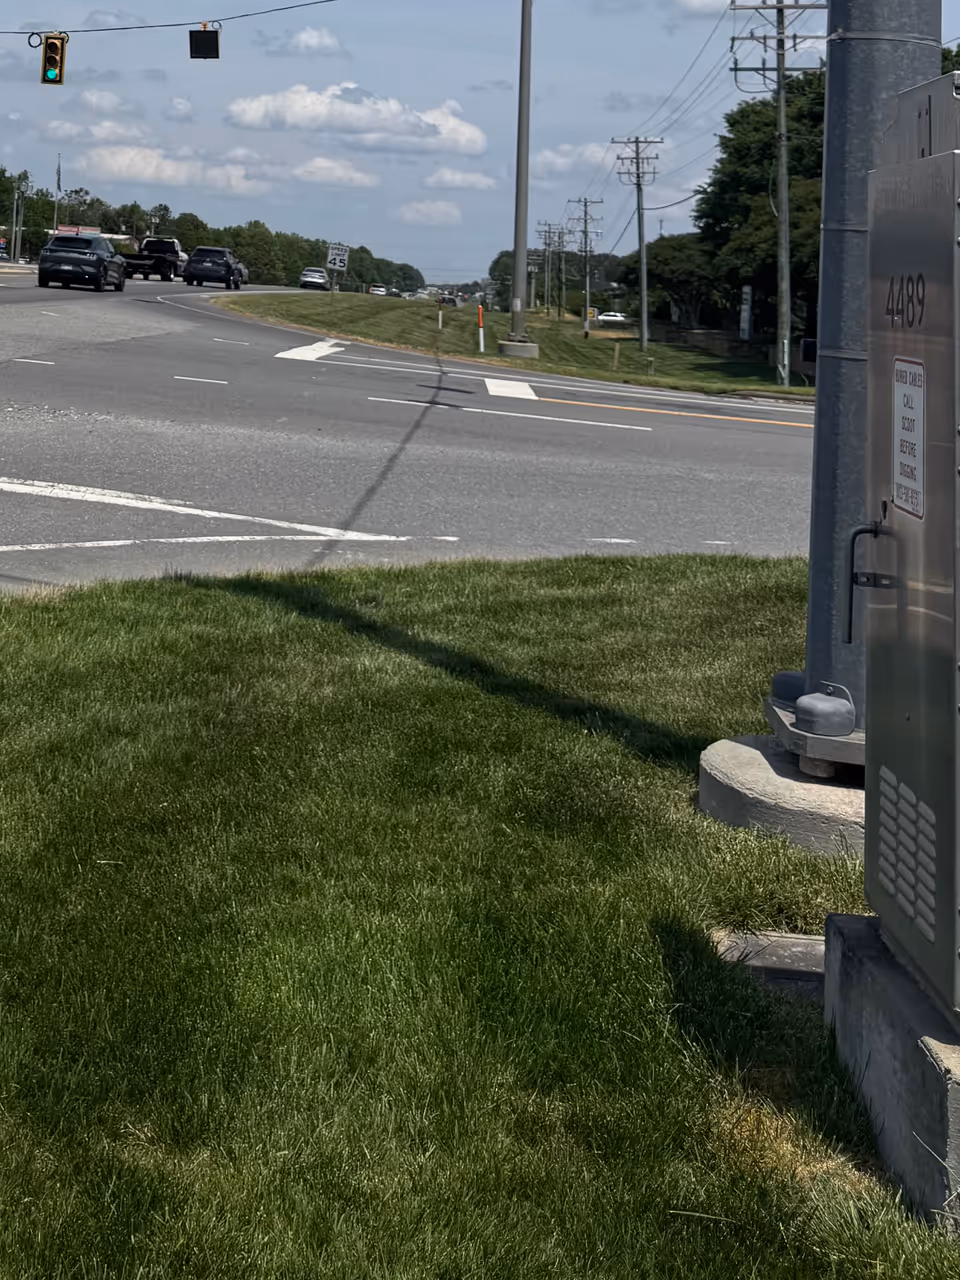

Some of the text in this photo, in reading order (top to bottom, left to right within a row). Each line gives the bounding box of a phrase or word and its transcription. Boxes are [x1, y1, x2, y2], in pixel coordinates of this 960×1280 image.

[328, 257, 346, 268] 45
[885, 273, 925, 328] 4489
[902, 393, 914, 410] CALL
[899, 438, 916, 458] BEFORE
[899, 461, 917, 481] DIGGING
